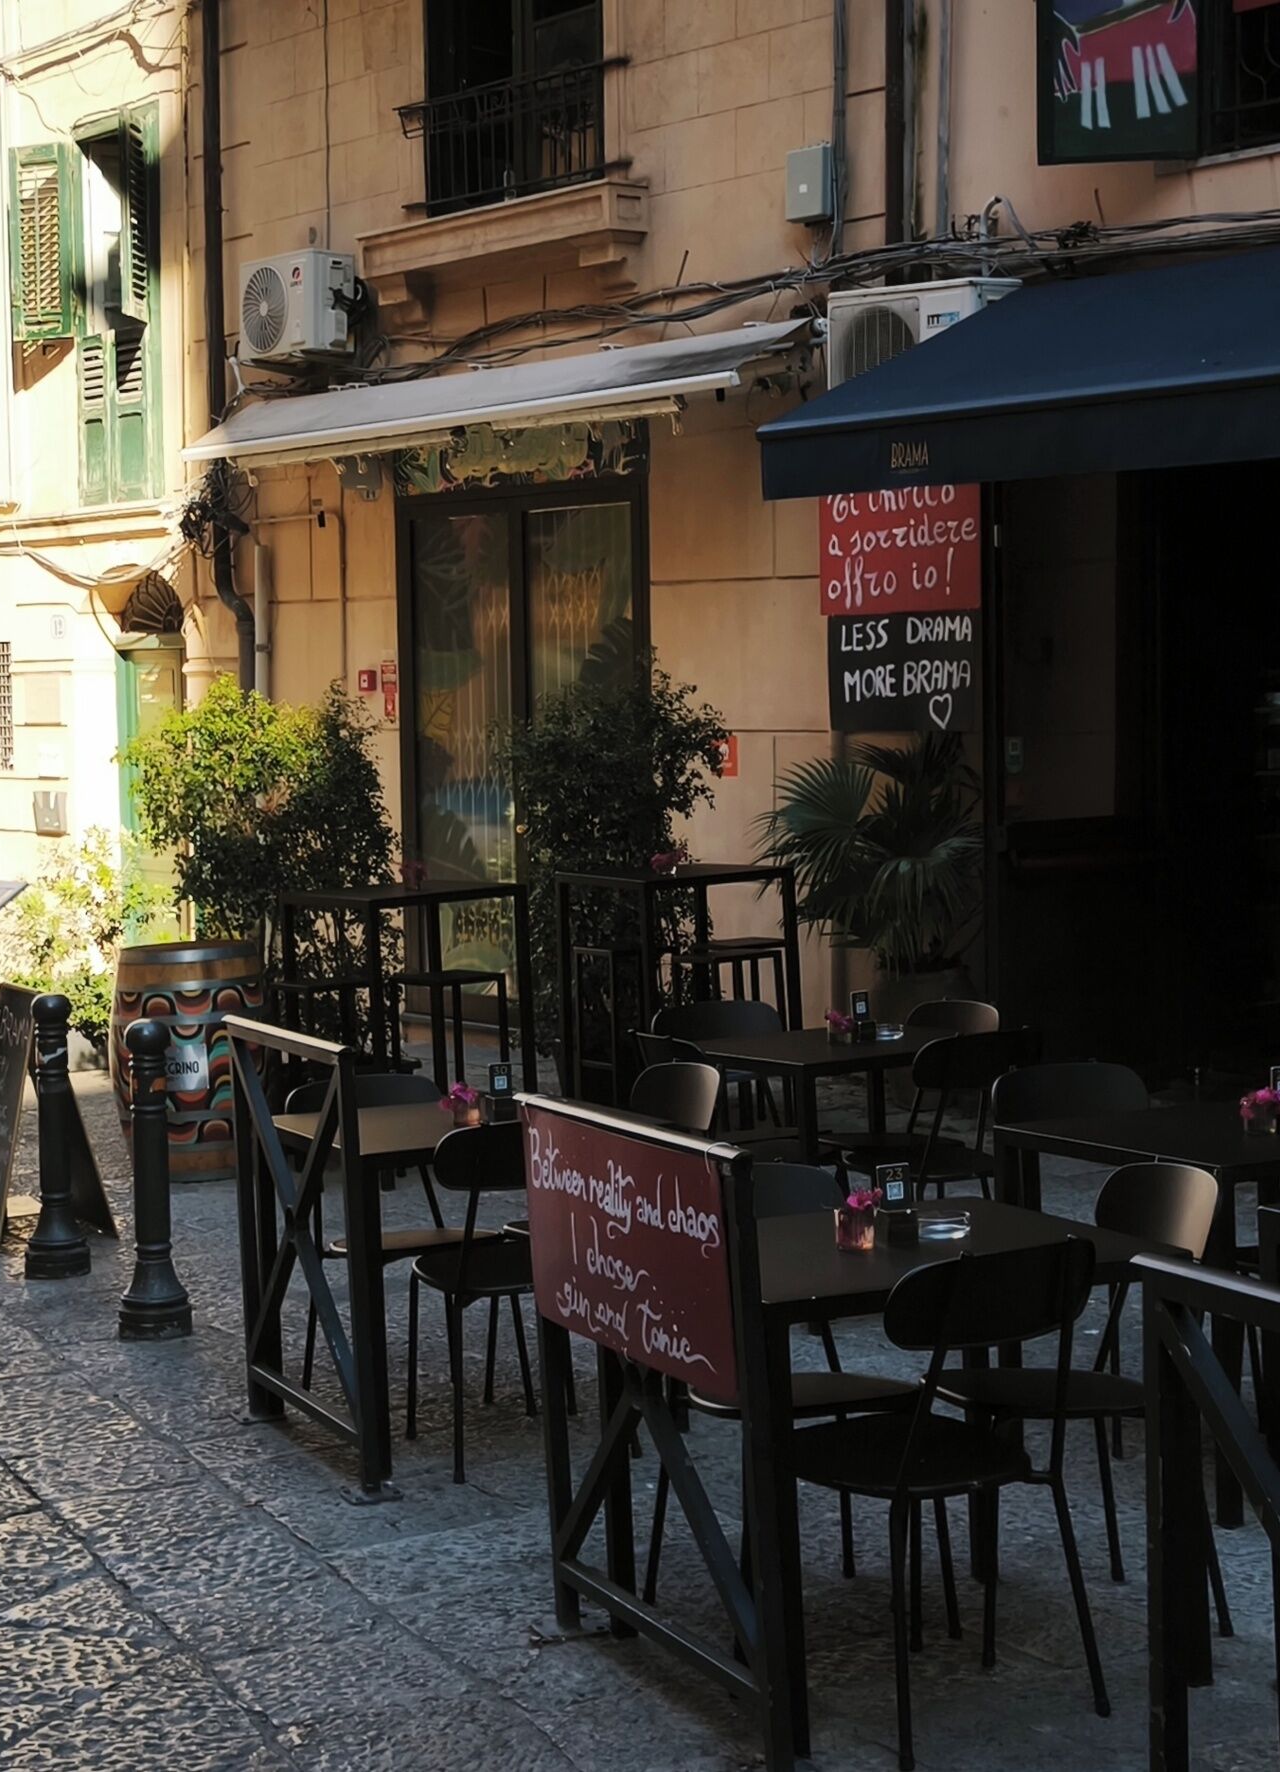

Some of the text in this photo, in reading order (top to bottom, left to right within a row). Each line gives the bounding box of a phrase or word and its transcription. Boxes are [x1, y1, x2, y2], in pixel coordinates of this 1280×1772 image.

[891, 440, 928, 468] BRAMA
[828, 512, 977, 556] a sorridere
[828, 555, 897, 610] offro
[840, 615, 972, 652] LESS DRAMA
[843, 659, 971, 703] MORE BRAMA
[528, 1125, 720, 1259] Between reality and chaos
[886, 1168, 903, 1181] 23
[571, 1212, 649, 1291] I chose
[556, 1276, 602, 1333] gin
[595, 1301, 629, 1341] and
